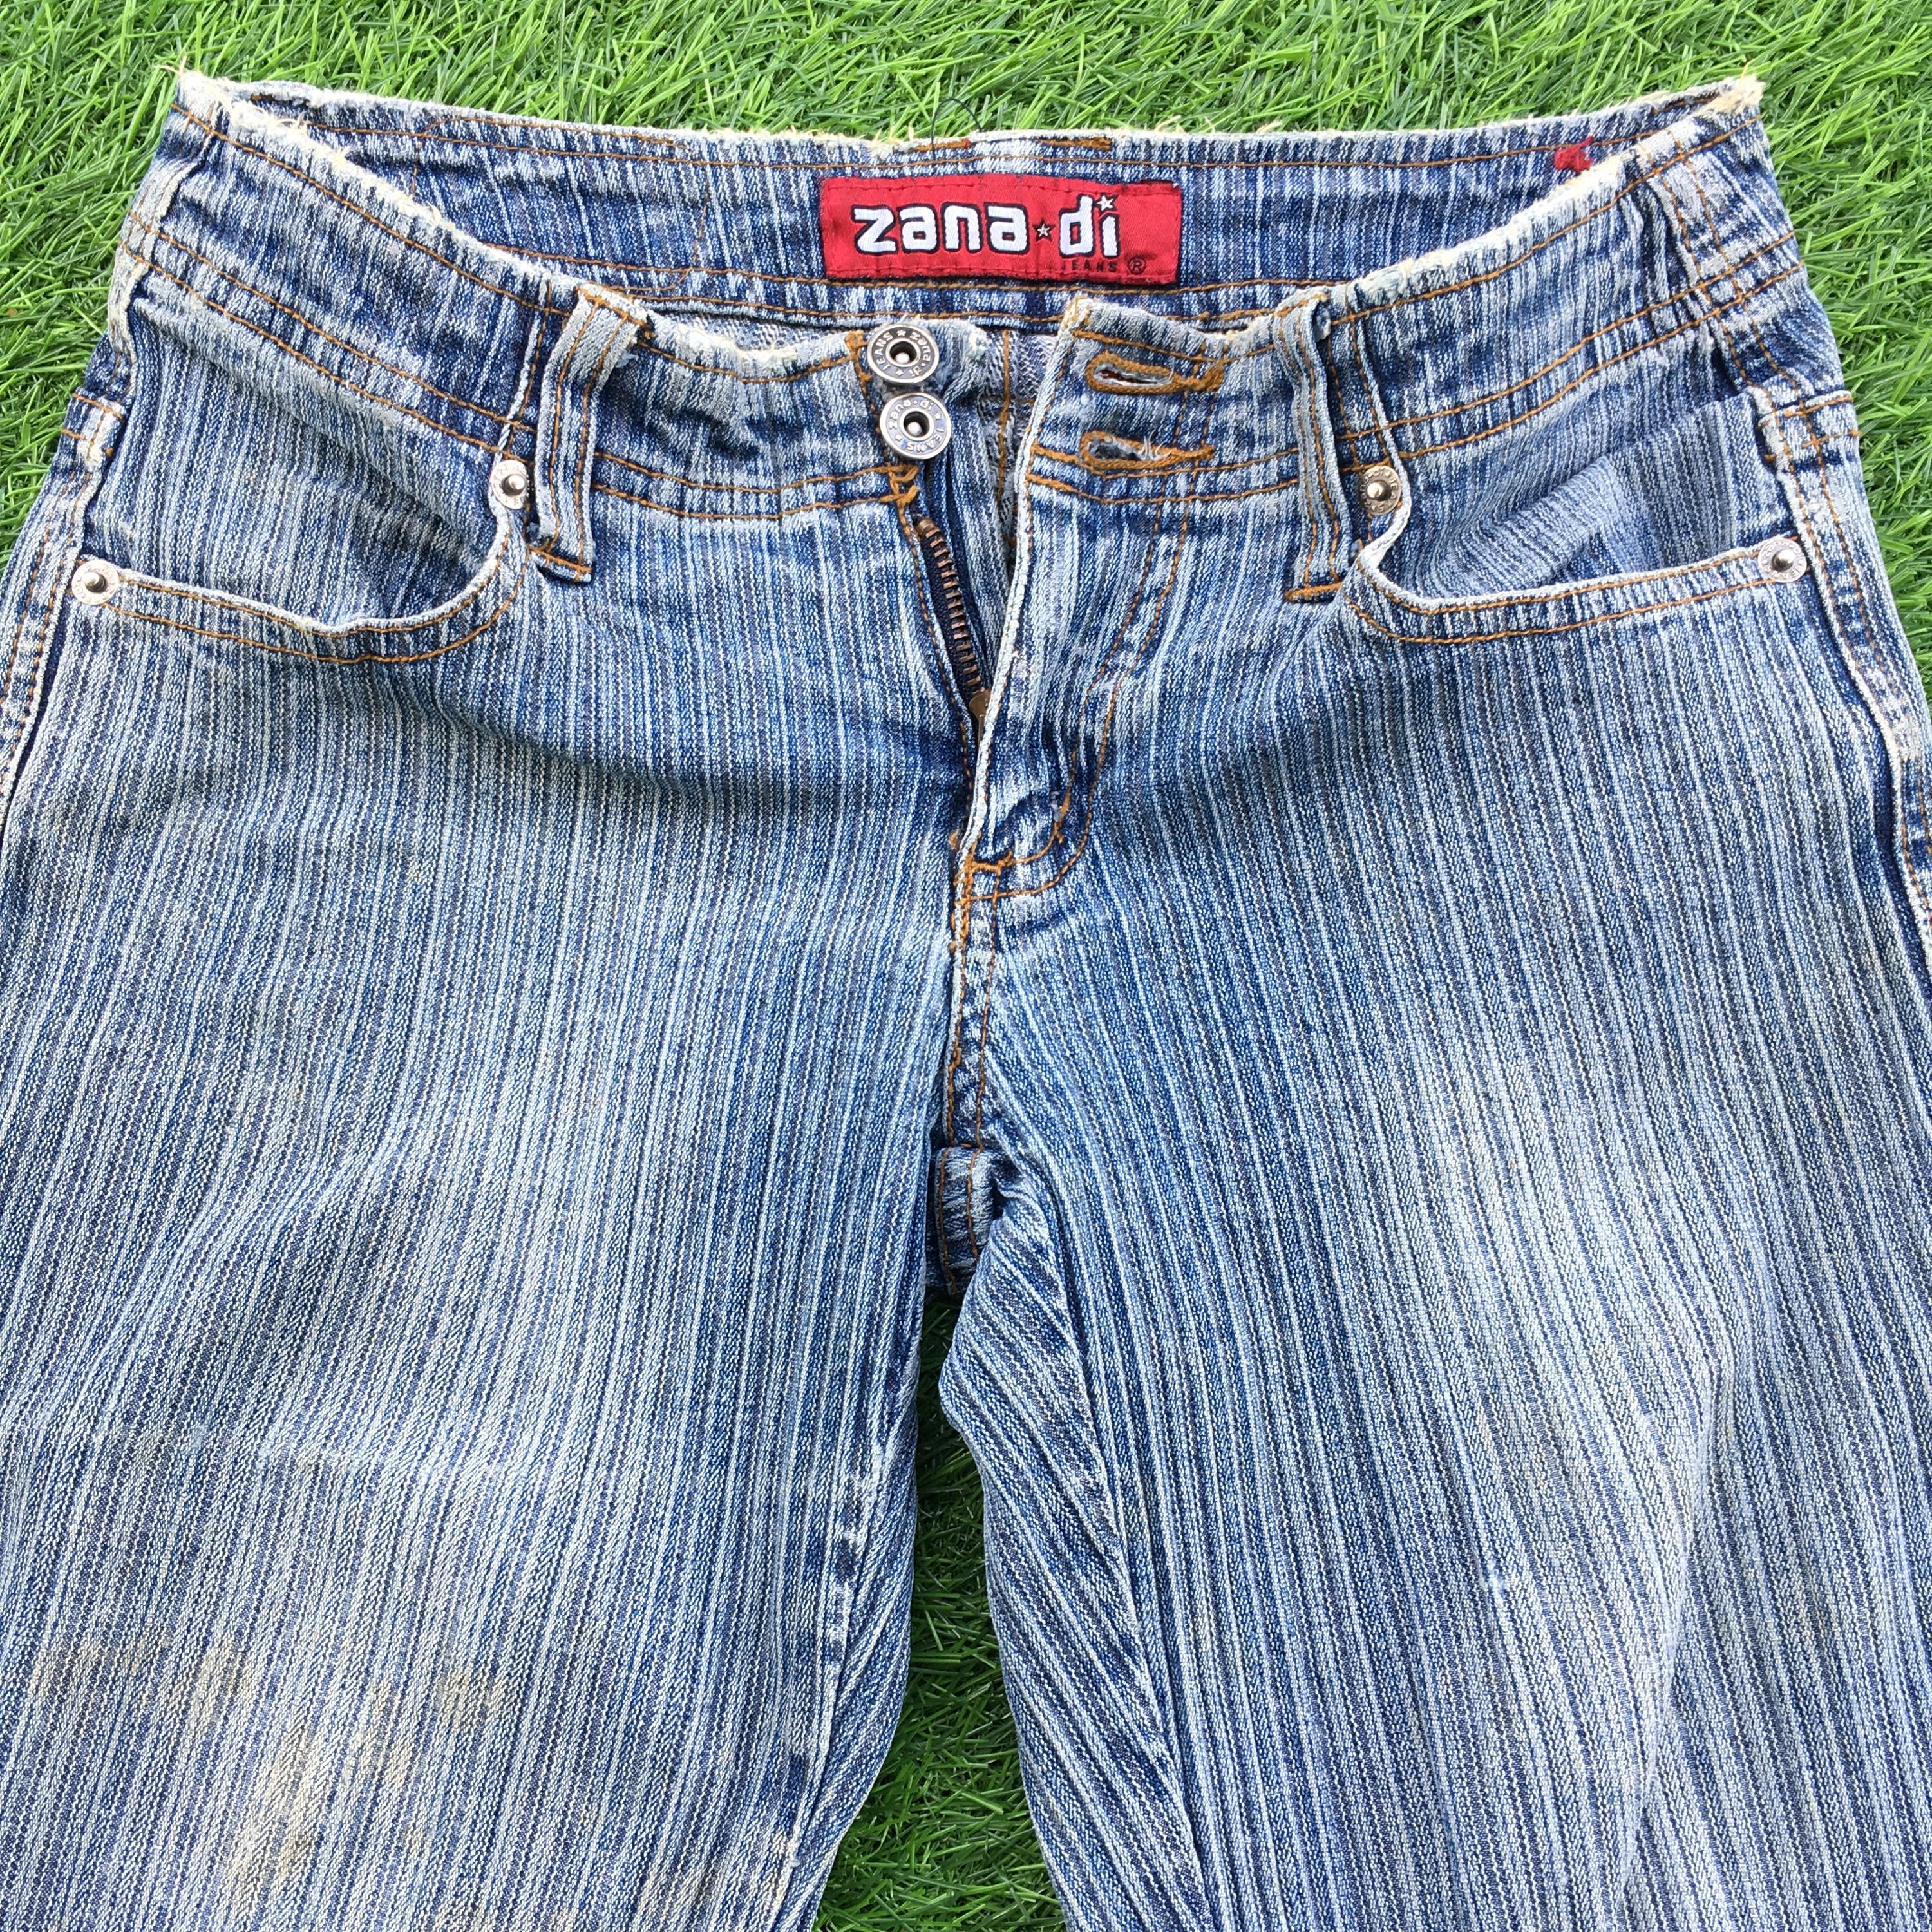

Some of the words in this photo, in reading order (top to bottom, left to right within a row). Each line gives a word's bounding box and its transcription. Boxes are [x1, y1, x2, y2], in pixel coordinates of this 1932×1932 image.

[851, 202, 1030, 255] zana
[1059, 192, 1122, 258] di
[1061, 259, 1117, 273] JEANS
[875, 332, 894, 370] JEANS
[889, 399, 911, 430] zana
[907, 427, 945, 452] JEANS
